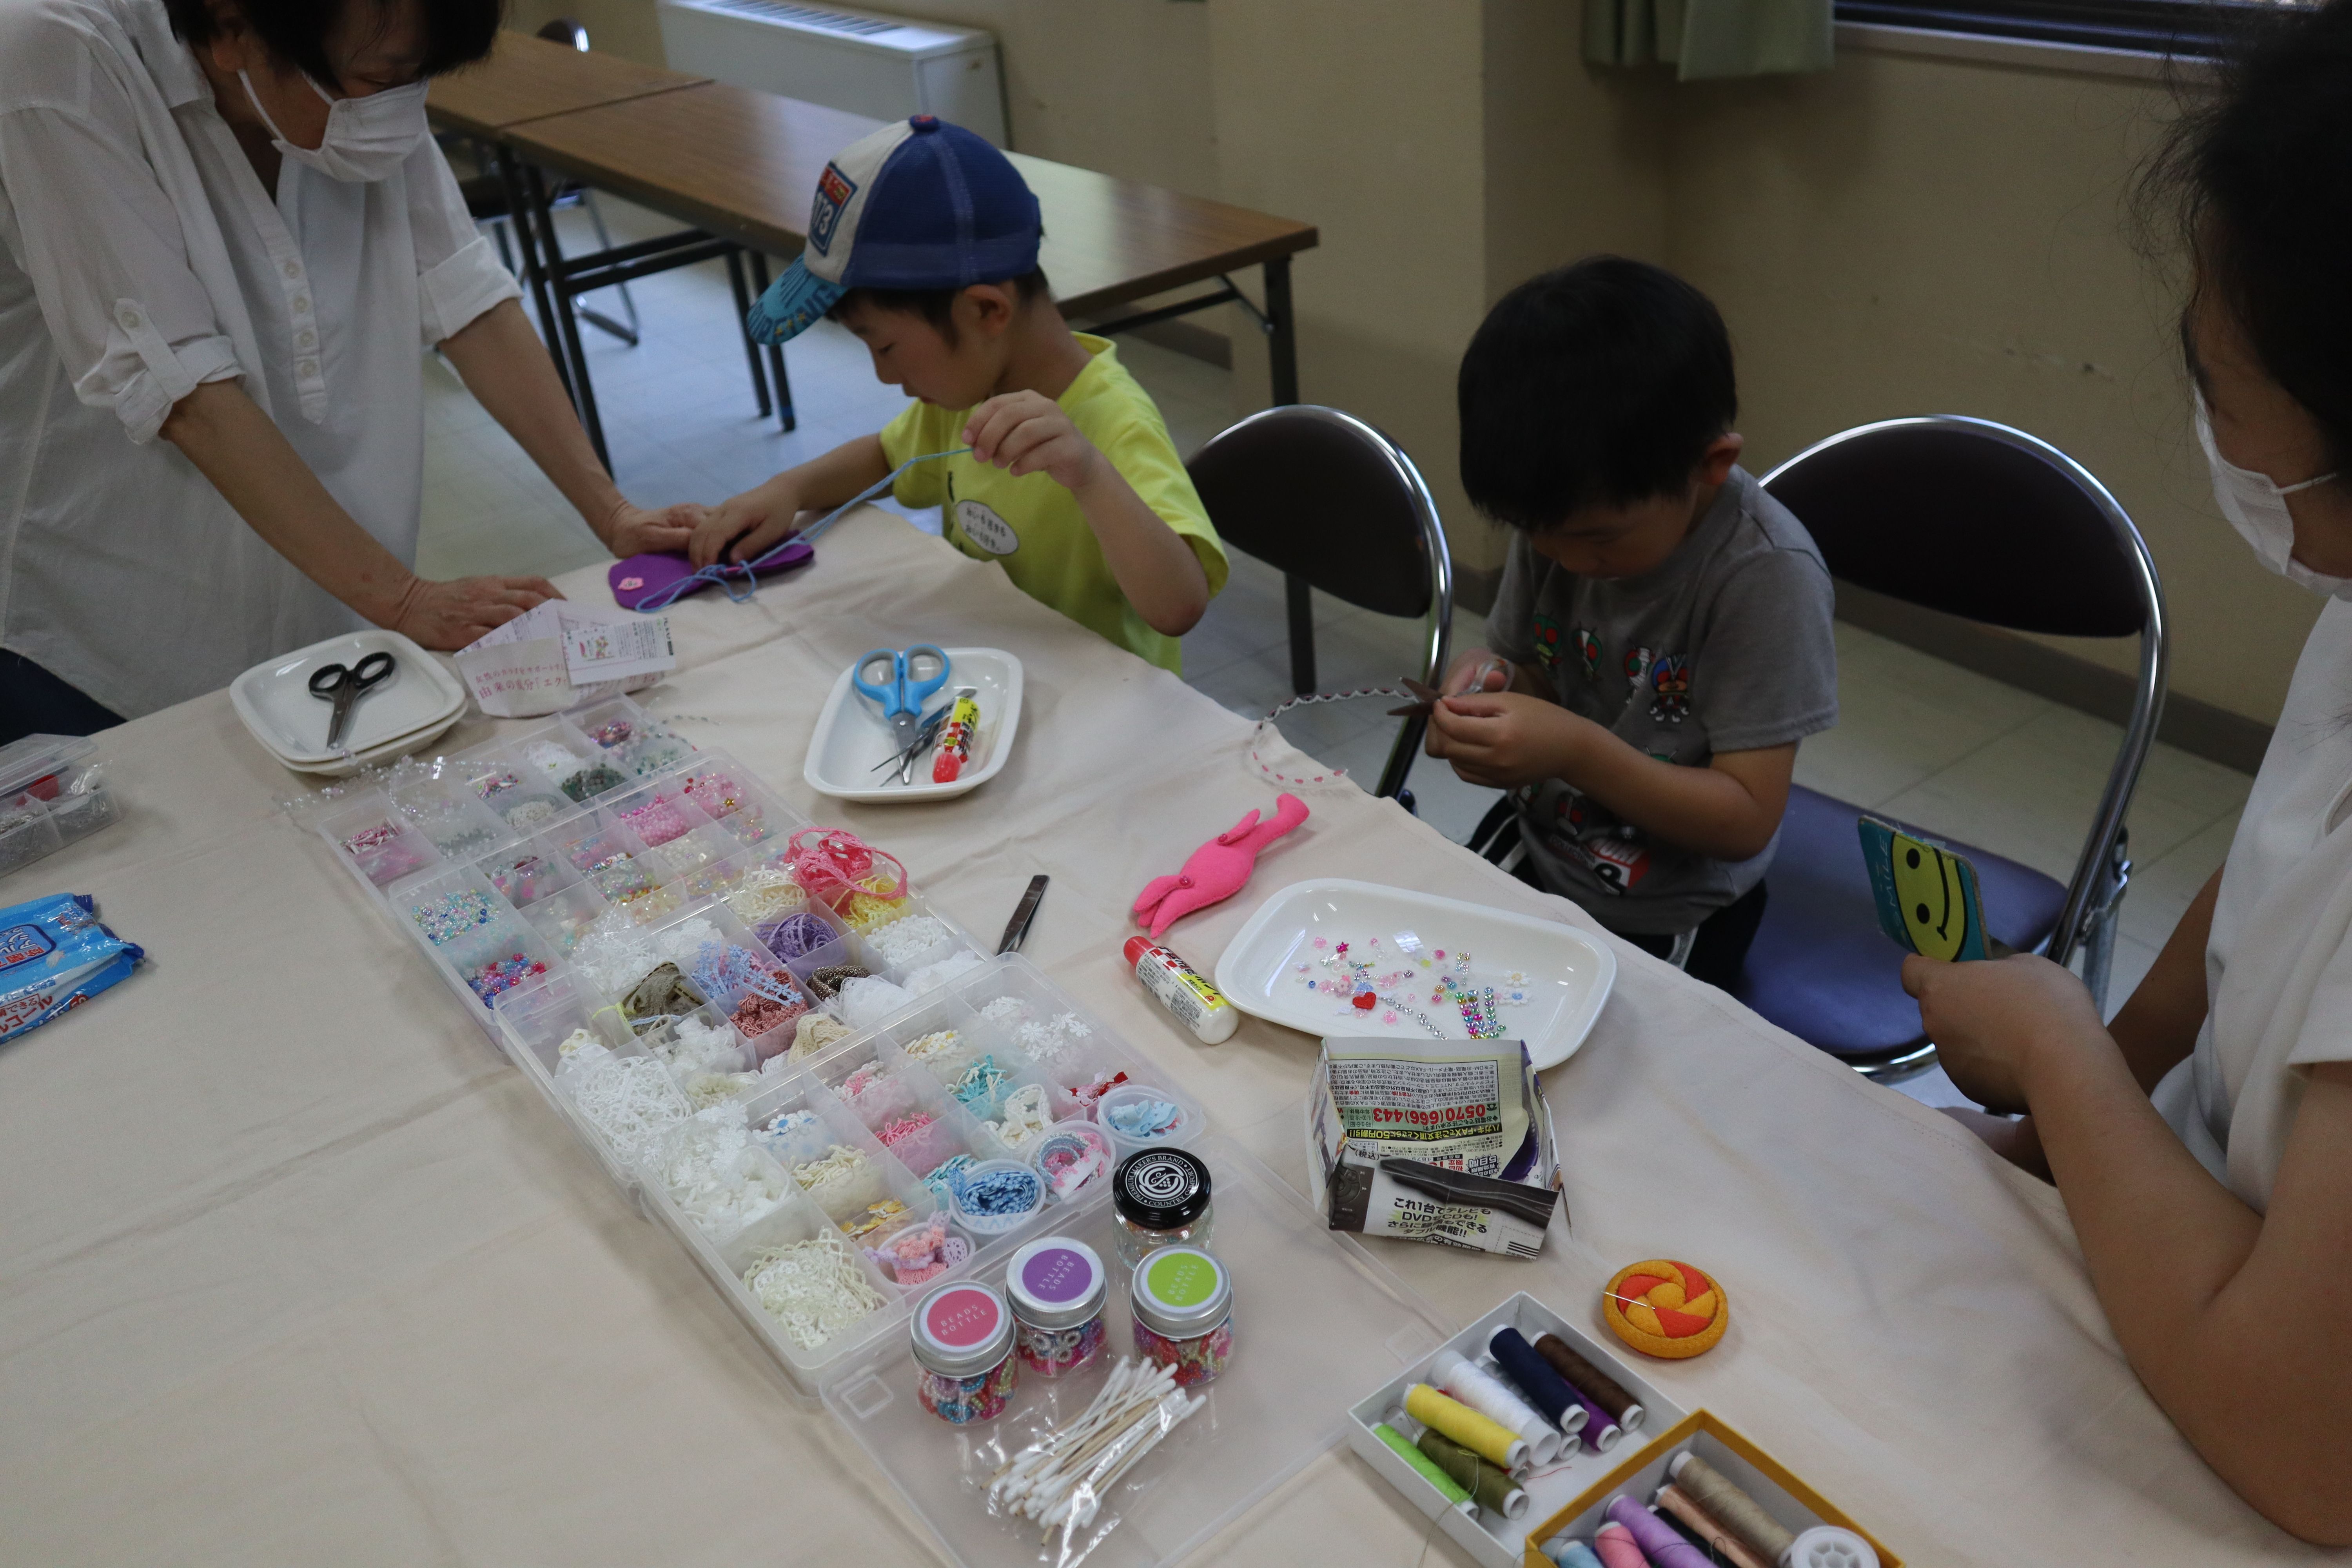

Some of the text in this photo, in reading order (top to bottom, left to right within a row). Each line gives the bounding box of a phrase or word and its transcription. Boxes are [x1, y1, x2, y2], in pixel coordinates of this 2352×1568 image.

[1373, 1104, 1486, 1126] 0570(666)443
[1355, 1150, 1380, 1161] (税込)
[1469, 1156, 1497, 1168] 5日間
[1127, 1156, 1184, 1202] PREMIUM MAKER'S BRAND
[1471, 1164, 1495, 1172] 有効期限
[1149, 1195, 1184, 1207] COUNTRY
[1394, 1198, 1491, 1214] これ1台でテレビも
[1037, 1255, 1069, 1290] BOTTLE
[1047, 1260, 1074, 1291] BEADS
[1168, 1263, 1189, 1296] BEADS
[1174, 1263, 1199, 1301] BOTTLE
[940, 1305, 979, 1327] BEADS
[942, 1310, 988, 1335] BOTTLE
